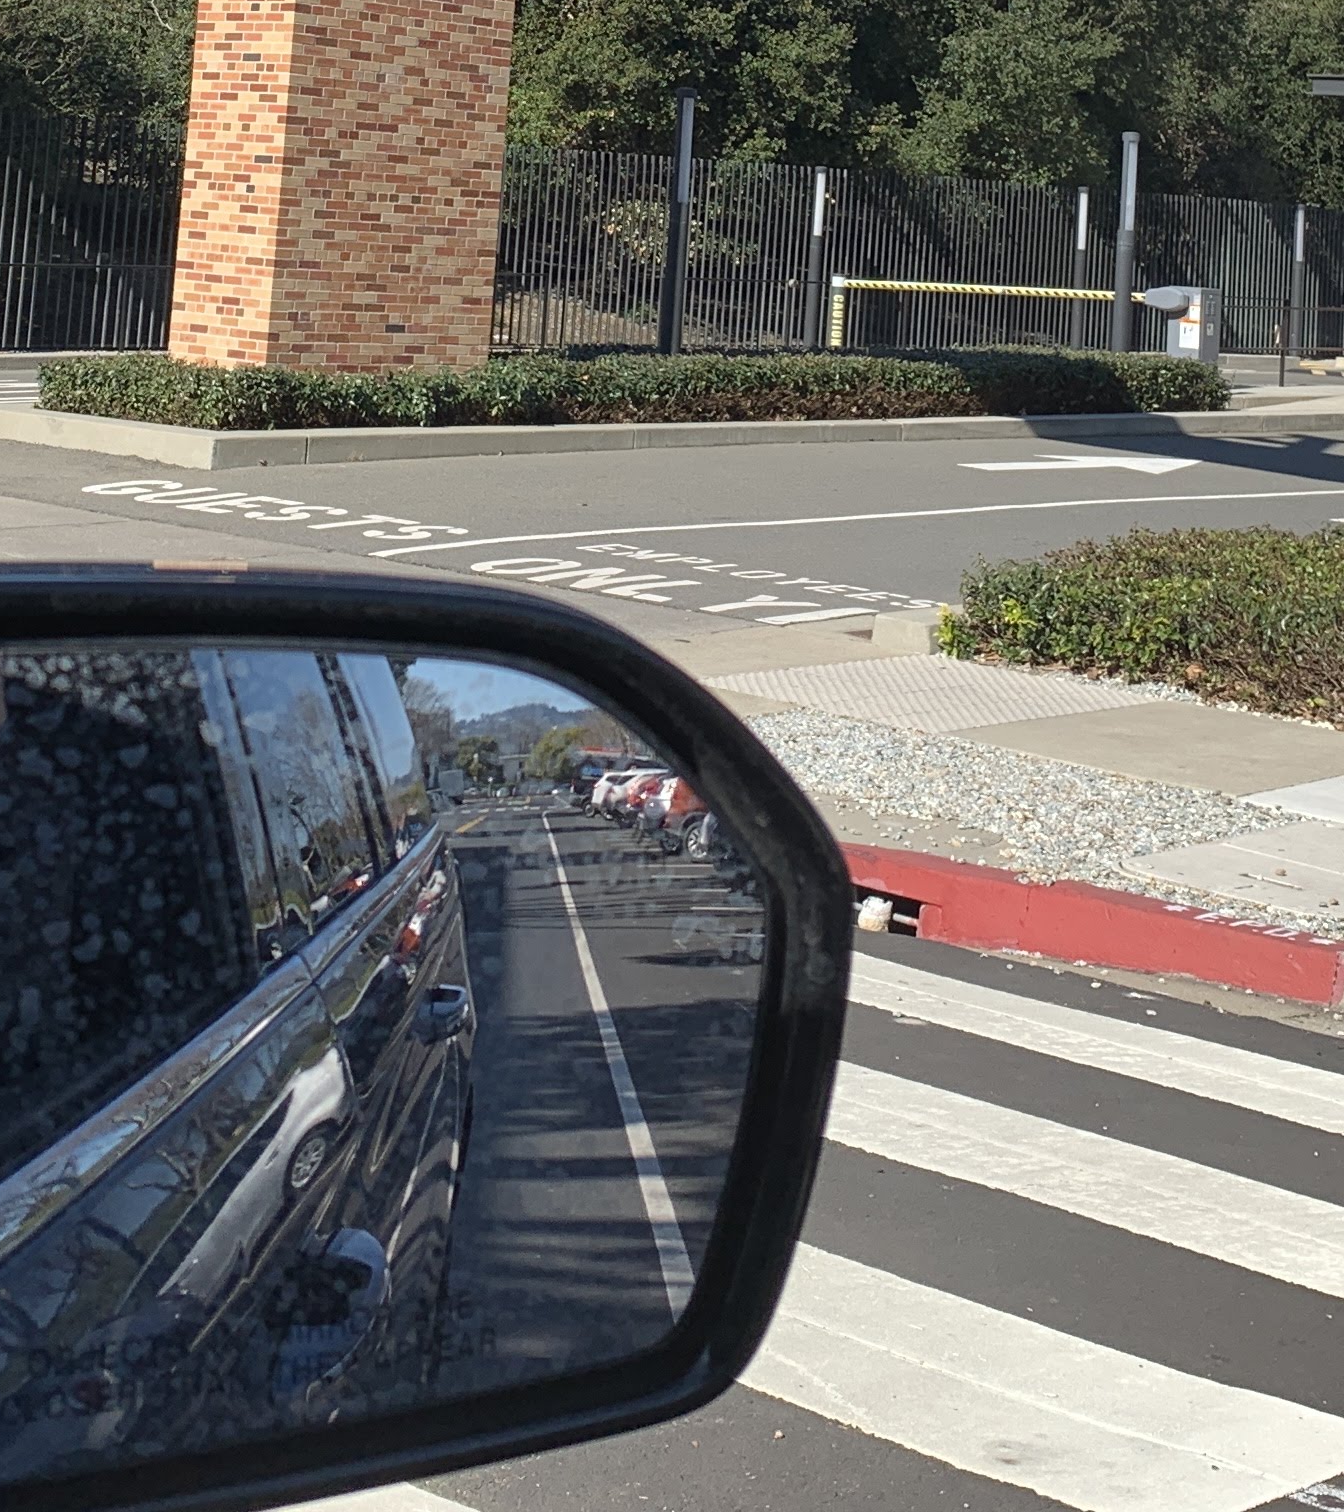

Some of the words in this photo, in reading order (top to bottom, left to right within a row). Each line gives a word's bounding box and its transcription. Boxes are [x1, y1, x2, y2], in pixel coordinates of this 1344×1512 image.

[830, 294, 845, 347] CAUTION
[81, 479, 470, 540] GUESTS
[470, 557, 823, 613] ONLY
[575, 543, 947, 609] EMPLOYEES
